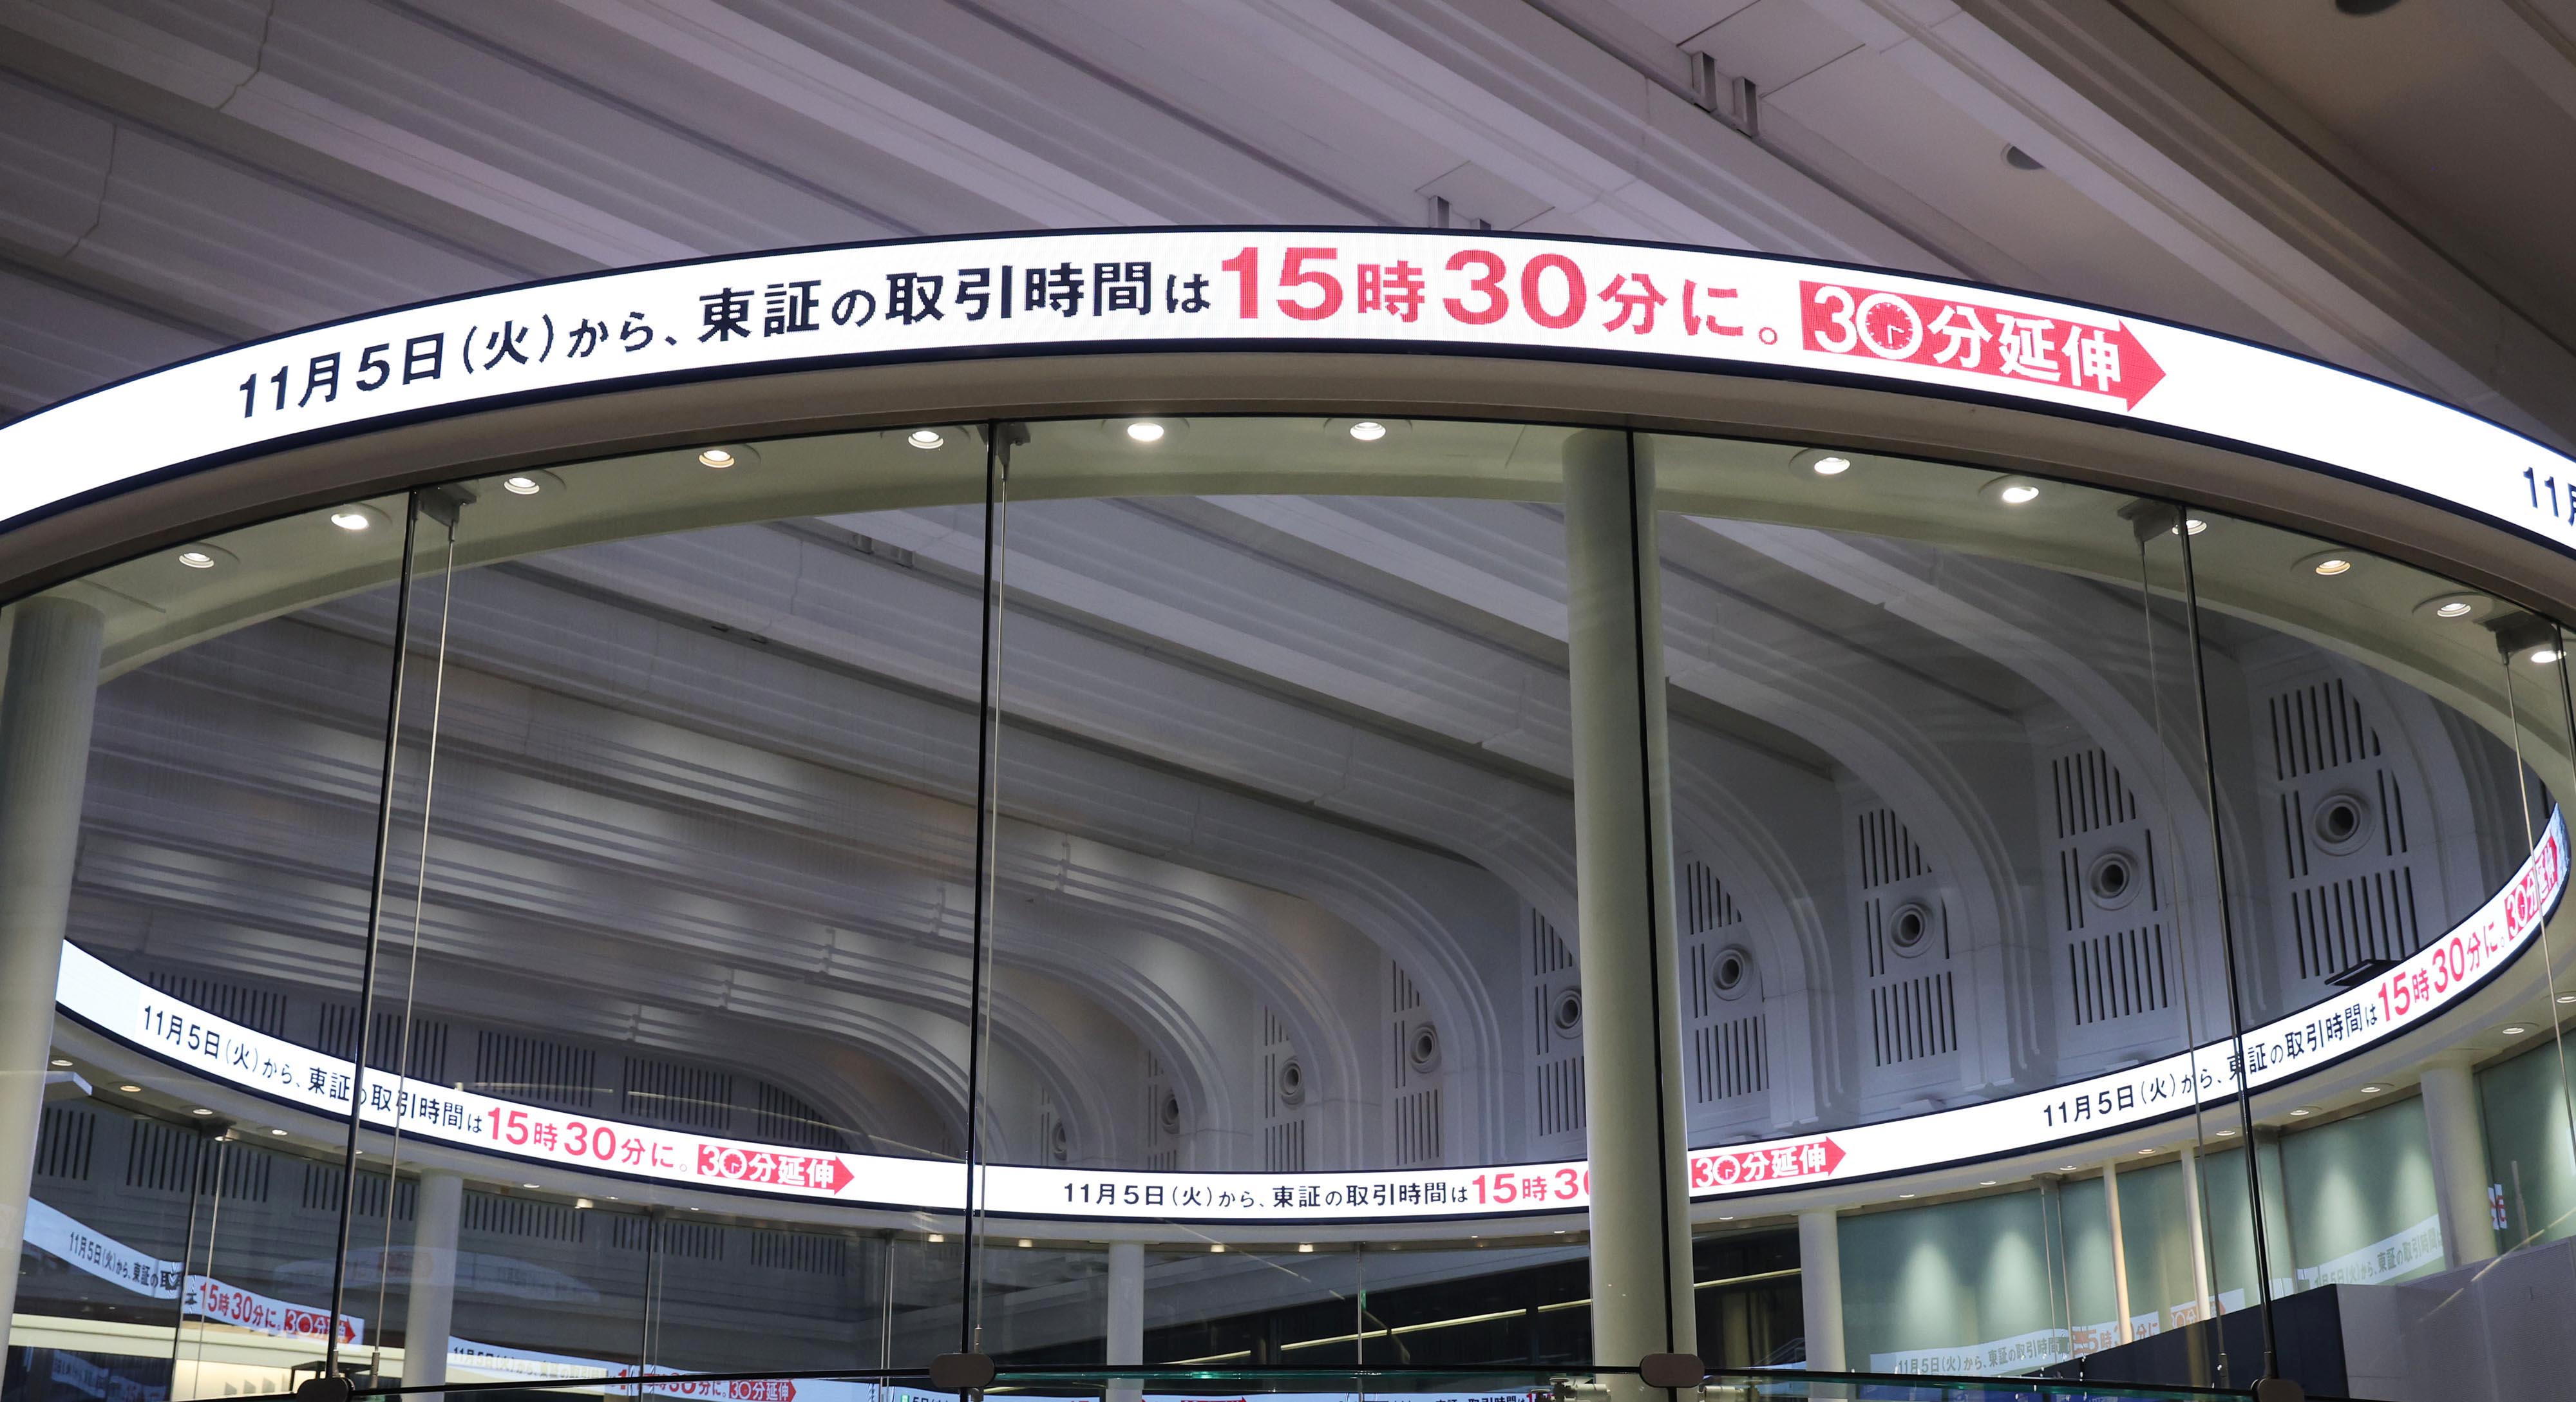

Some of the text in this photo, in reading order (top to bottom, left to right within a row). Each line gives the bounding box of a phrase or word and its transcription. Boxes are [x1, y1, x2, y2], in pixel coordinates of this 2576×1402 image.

[1814, 285, 2122, 392] 30分延伸
[1065, 1168, 1589, 1208] 11月5日（火）から、東証の取引時間は15時3
